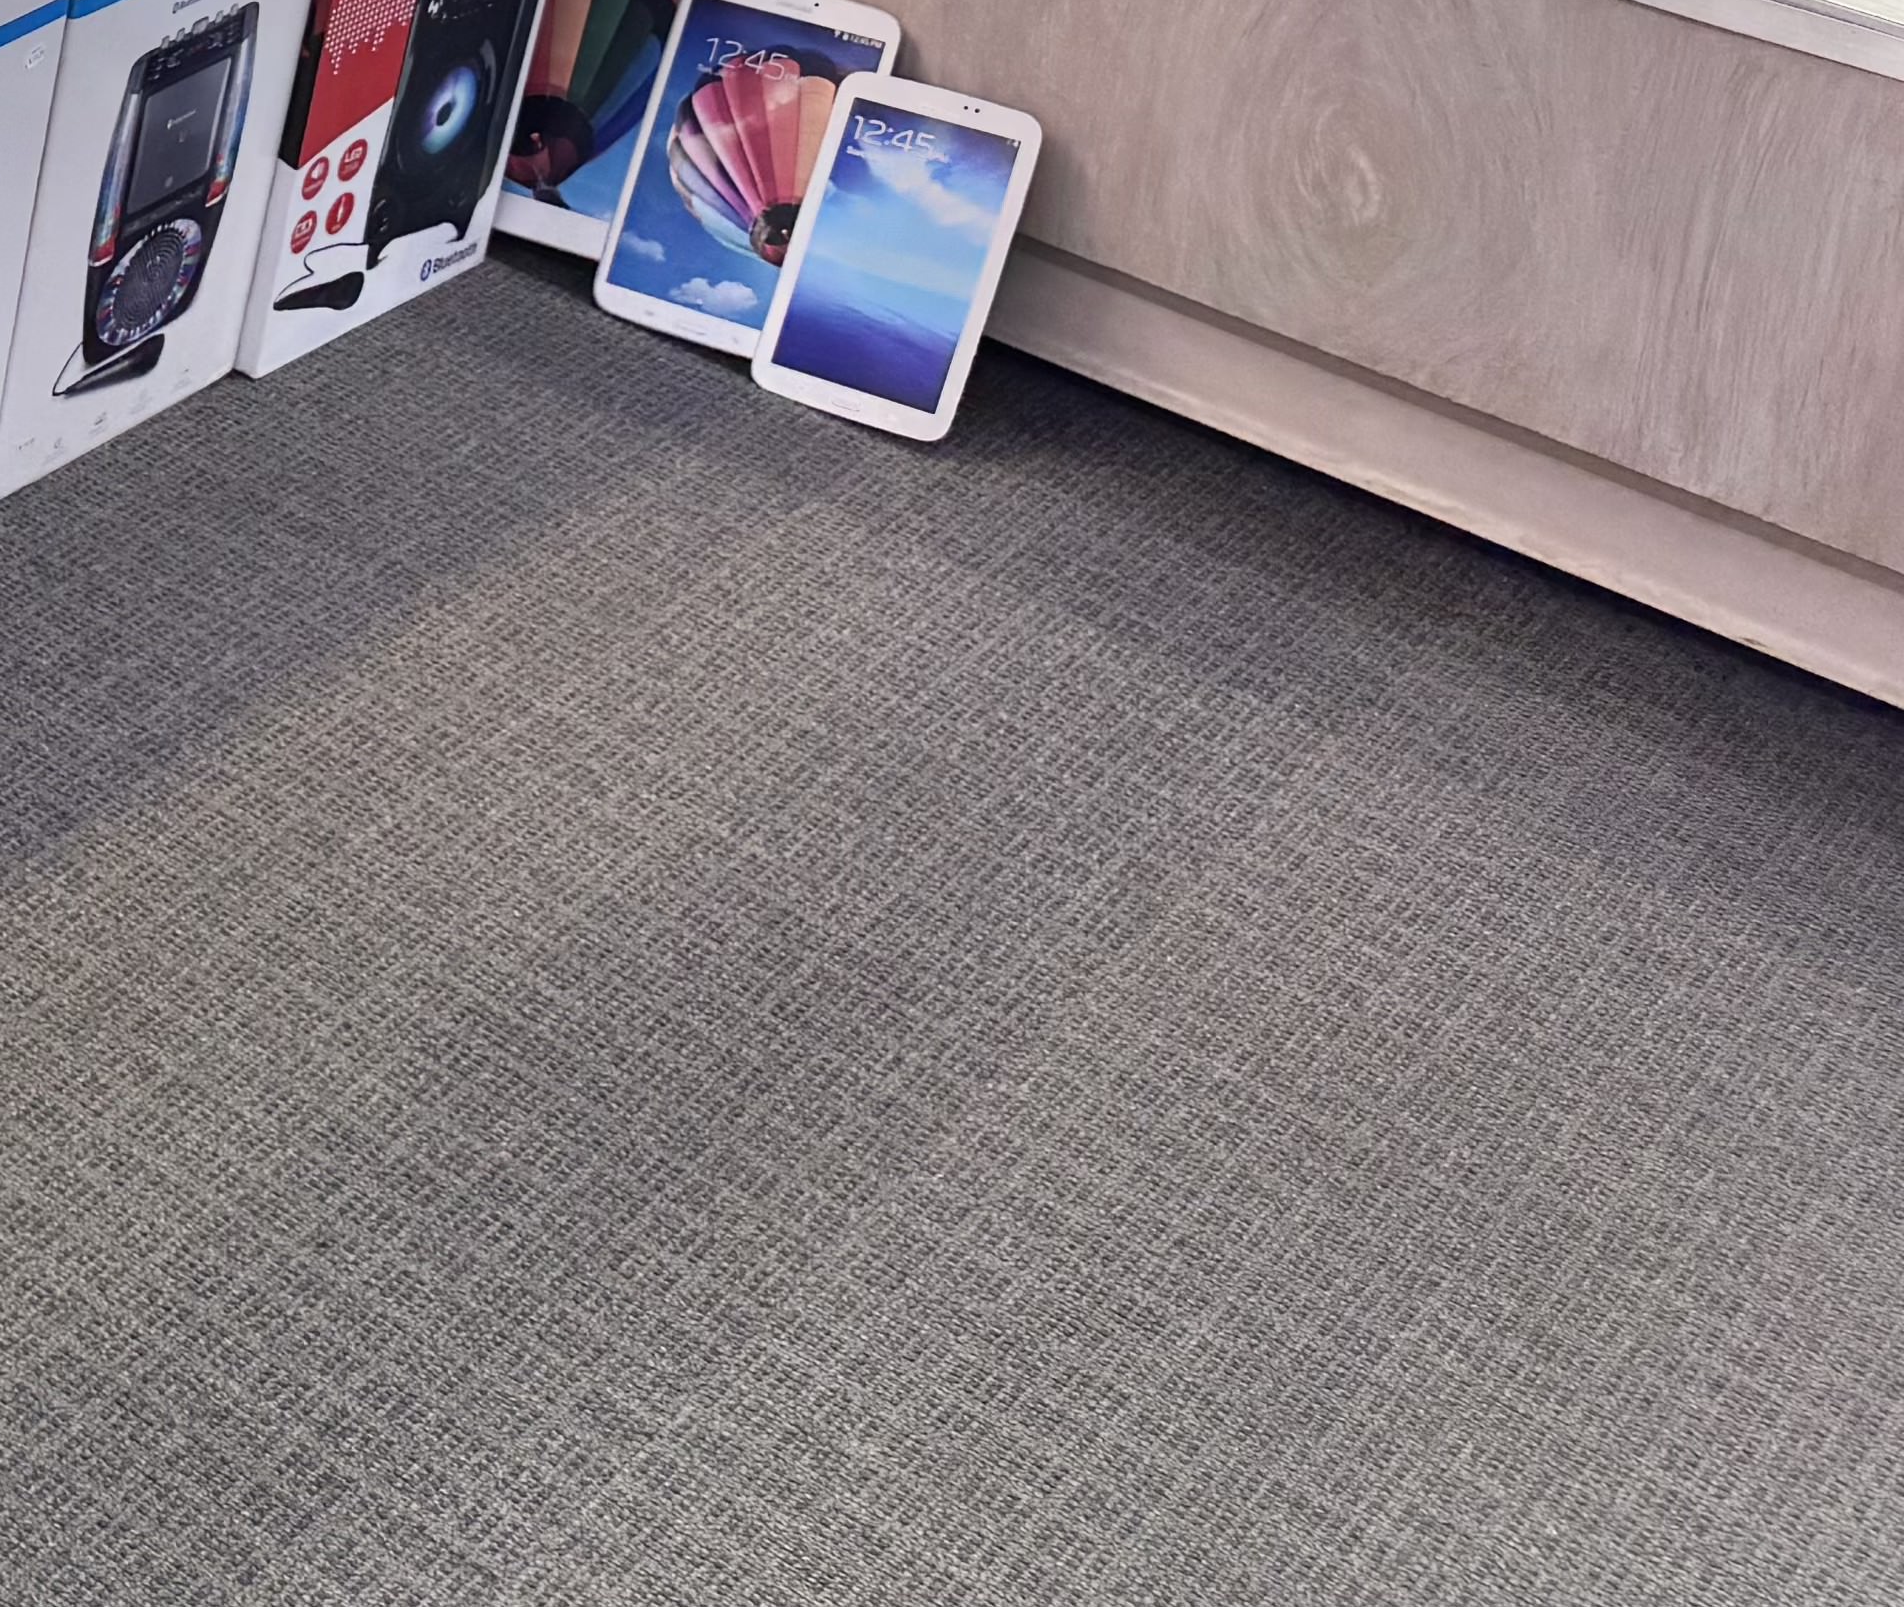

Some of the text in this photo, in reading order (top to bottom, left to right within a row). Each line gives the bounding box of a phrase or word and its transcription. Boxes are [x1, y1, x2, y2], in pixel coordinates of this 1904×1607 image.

[702, 36, 787, 84] 12:45
[851, 114, 938, 155] 12:45
[432, 240, 479, 275] Bluetooth
